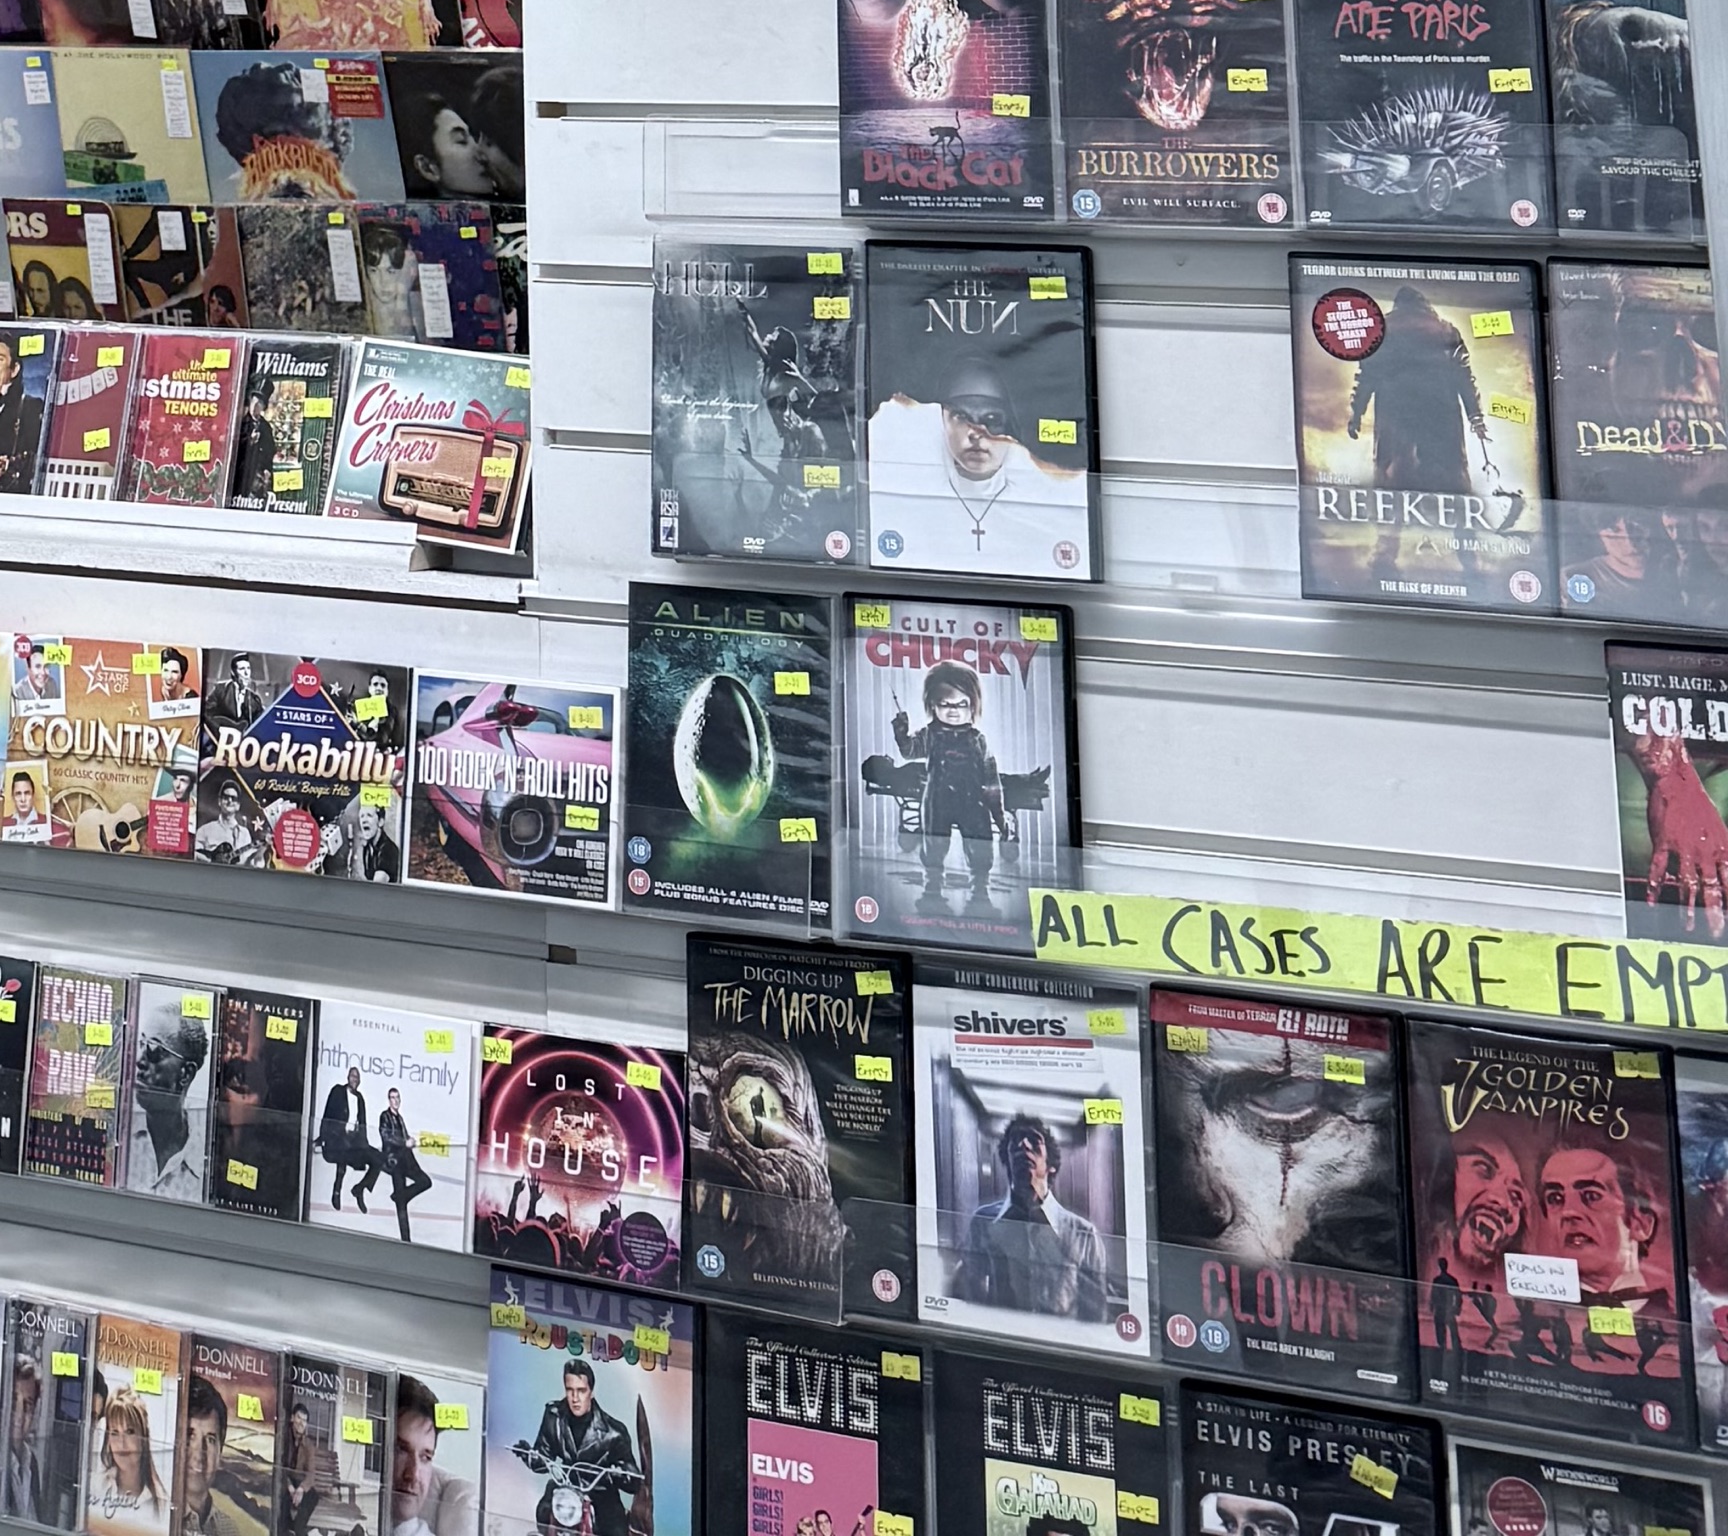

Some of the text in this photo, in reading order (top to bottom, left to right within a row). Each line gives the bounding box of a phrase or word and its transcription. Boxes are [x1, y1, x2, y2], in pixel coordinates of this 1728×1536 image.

[1334, 0, 1491, 41] ATE PARIS
[863, 149, 1024, 191] Black Cat
[1077, 149, 1279, 180] BURROWERS
[1122, 197, 1182, 208] EVIL WILL
[925, 298, 1021, 335] NUN
[255, 353, 329, 377] Williams
[164, 400, 218, 418] TENORS
[354, 382, 456, 426] Christmas
[349, 423, 438, 467] Crooners
[1316, 486, 1492, 529] REEKER
[654, 601, 805, 628] ALIEN
[901, 616, 1003, 637] CULT OF
[865, 636, 1041, 690] CHUCKY
[1622, 672, 1665, 691] LUST.
[281, 711, 324, 722] STARS
[22, 716, 183, 769] COUNTRY
[215, 727, 396, 786] Rockabilly
[417, 746, 609, 803] 100 ROCK ROLL HITS
[1037, 895, 1507, 1010] ALL CASES ARE
[743, 966, 843, 988] DIGGING UP
[704, 982, 875, 1050] THE MARROW
[954, 1009, 1066, 1036] shivers
[1276, 1008, 1350, 1041] ELI ROTH
[398, 1055, 459, 1095] Family
[1499, 1048, 1599, 1072] LEGEND THE
[527, 1069, 624, 1100] LOST
[1480, 1066, 1613, 1100] GOLDEN
[490, 1132, 658, 1188] HOUSE
[1200, 1259, 1359, 1340] CLOWN
[1646, 1407, 1666, 1425] 16
